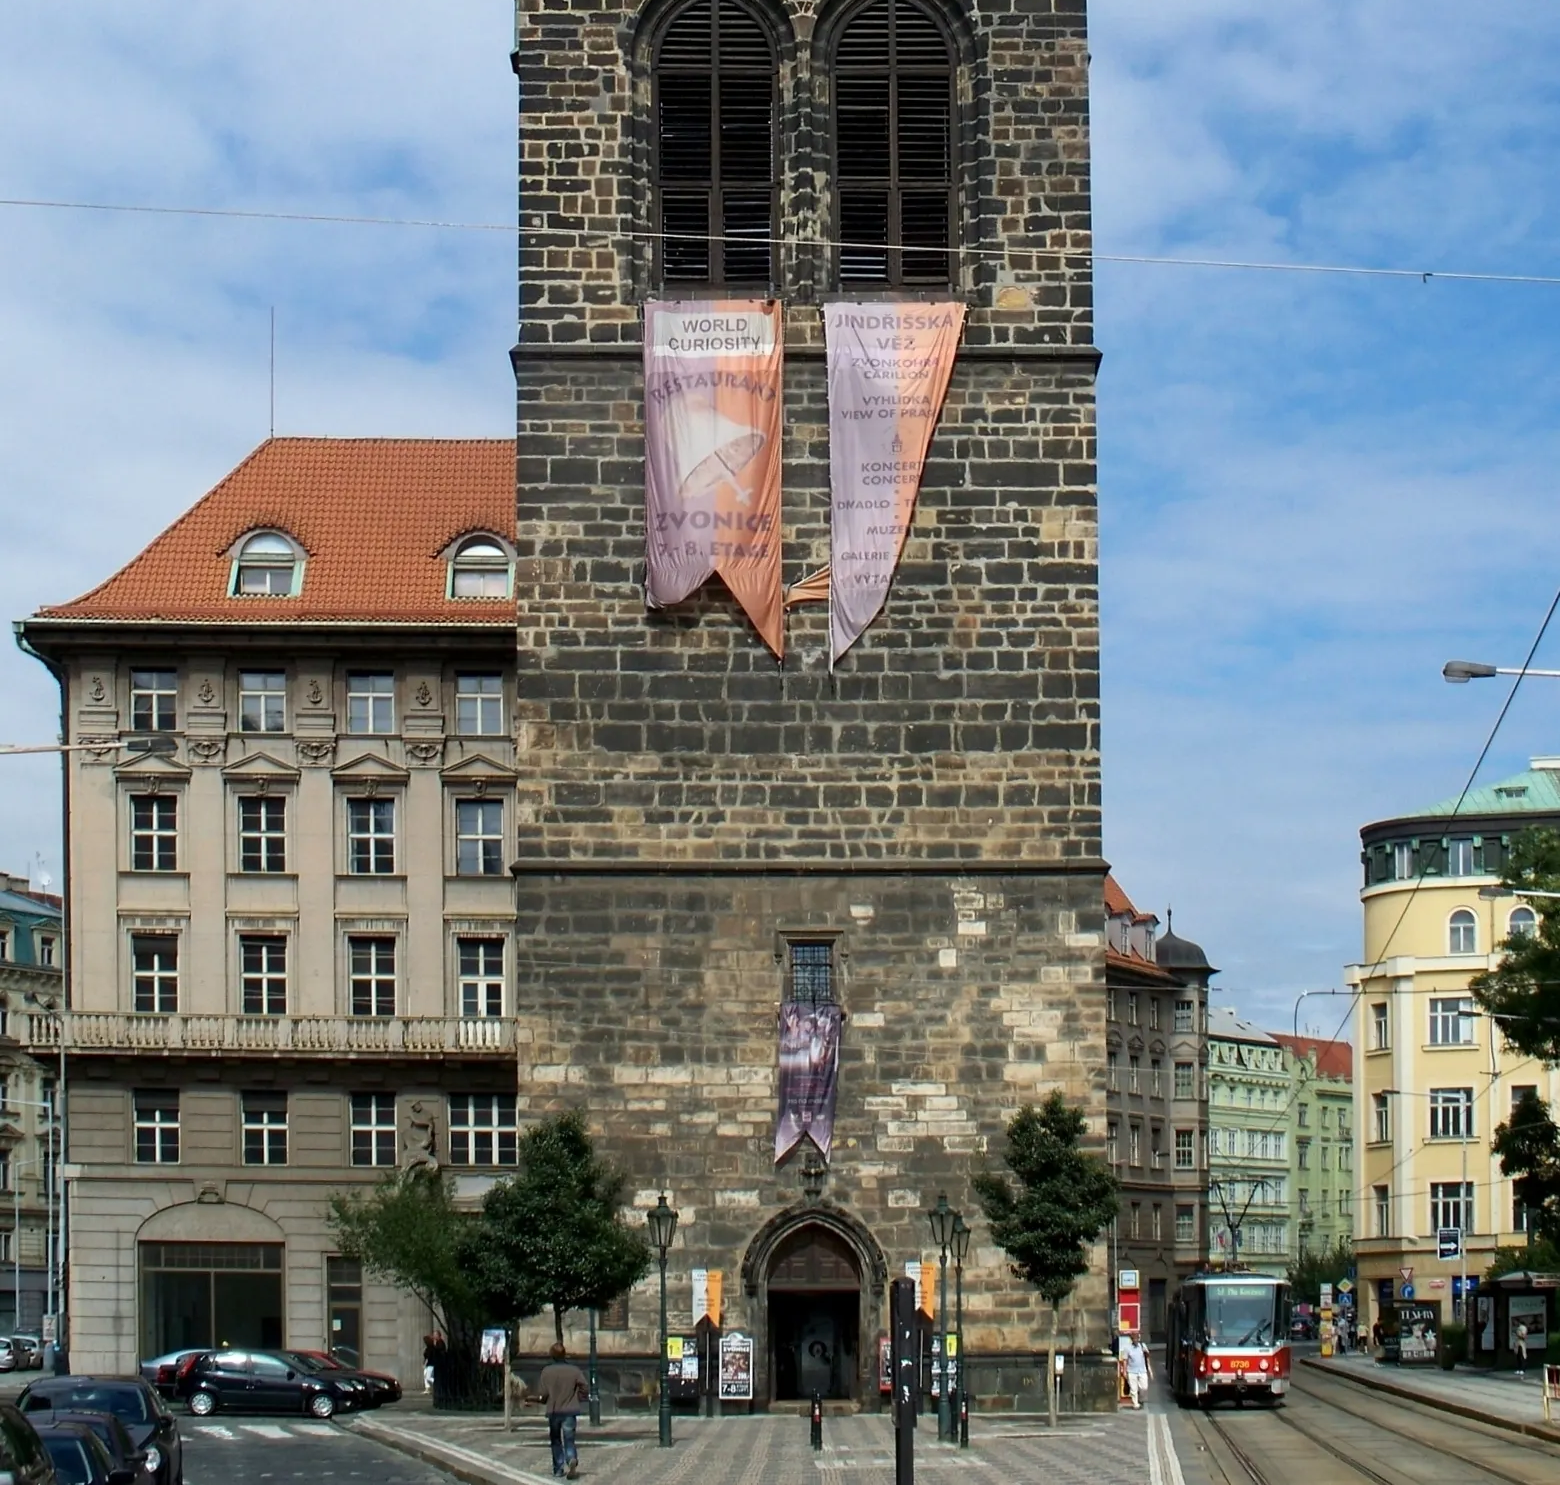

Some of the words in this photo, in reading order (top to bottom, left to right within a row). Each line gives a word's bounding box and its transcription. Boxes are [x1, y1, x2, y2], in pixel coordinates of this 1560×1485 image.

[682, 318, 747, 334] WORLD
[668, 335, 761, 352] CURIOSITY
[864, 370, 929, 380] CARILLON
[649, 371, 777, 405] RESTAURANT
[841, 410, 873, 420] VIEW
[878, 409, 897, 419] OF
[656, 510, 771, 532] ZVONICE
[841, 551, 890, 561] GALERIE
[854, 572, 890, 584] VÝTA
[1230, 1360, 1250, 1369] 8736
